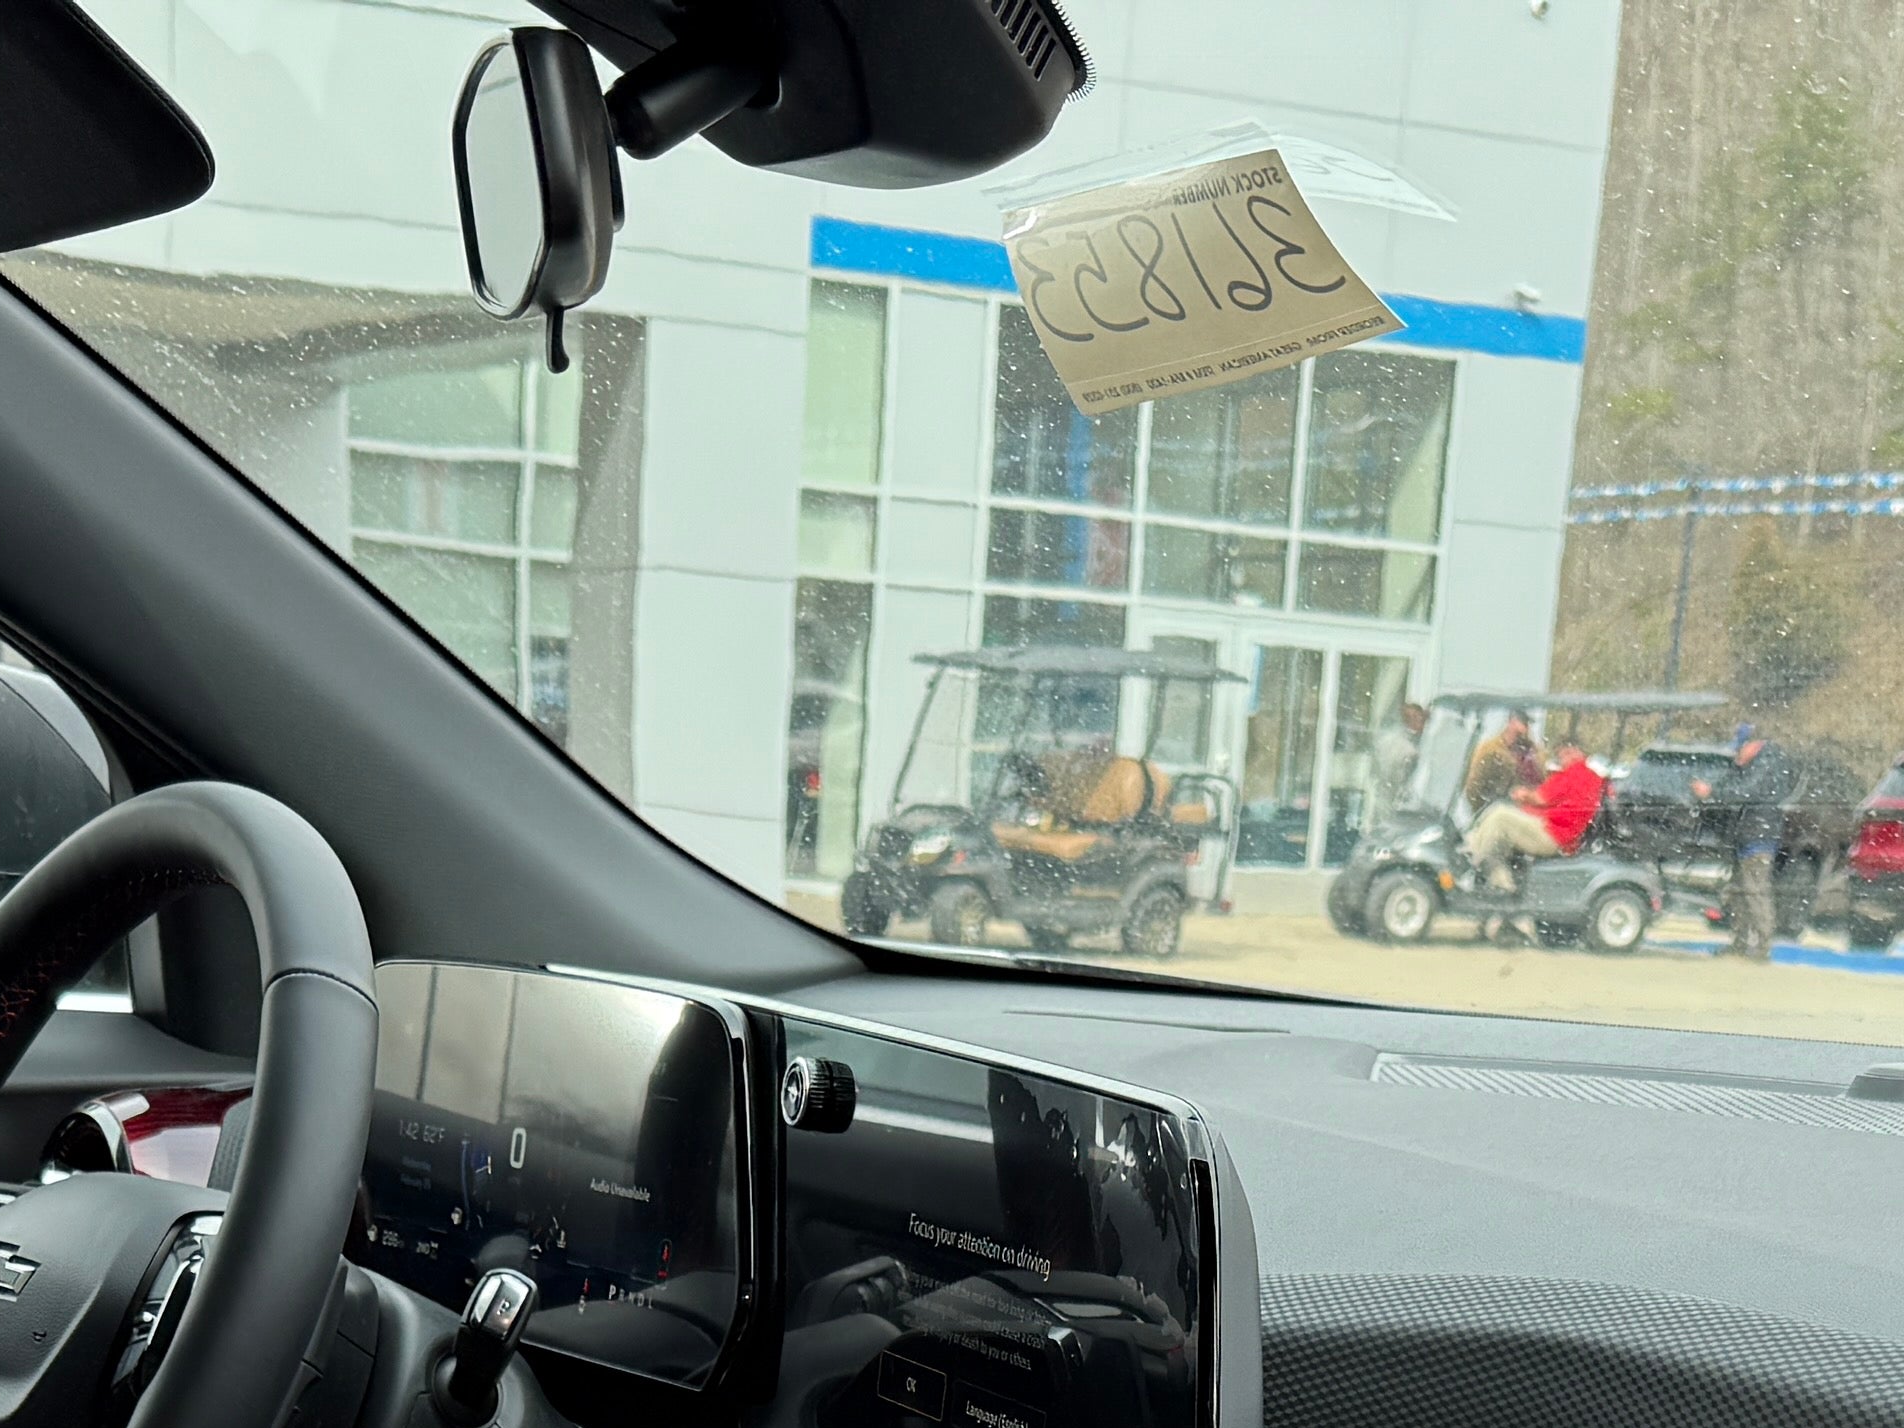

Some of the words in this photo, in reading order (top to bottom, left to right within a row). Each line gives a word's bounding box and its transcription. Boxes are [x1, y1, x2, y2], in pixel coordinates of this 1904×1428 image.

[510, 1127, 527, 1169] 0
[908, 1213, 934, 1240] Focus
[934, 1226, 957, 1247] your
[957, 1231, 1000, 1260] attention
[1001, 1246, 1015, 1264] on
[1016, 1244, 1051, 1282] driving
[966, 1400, 998, 1428] Language
